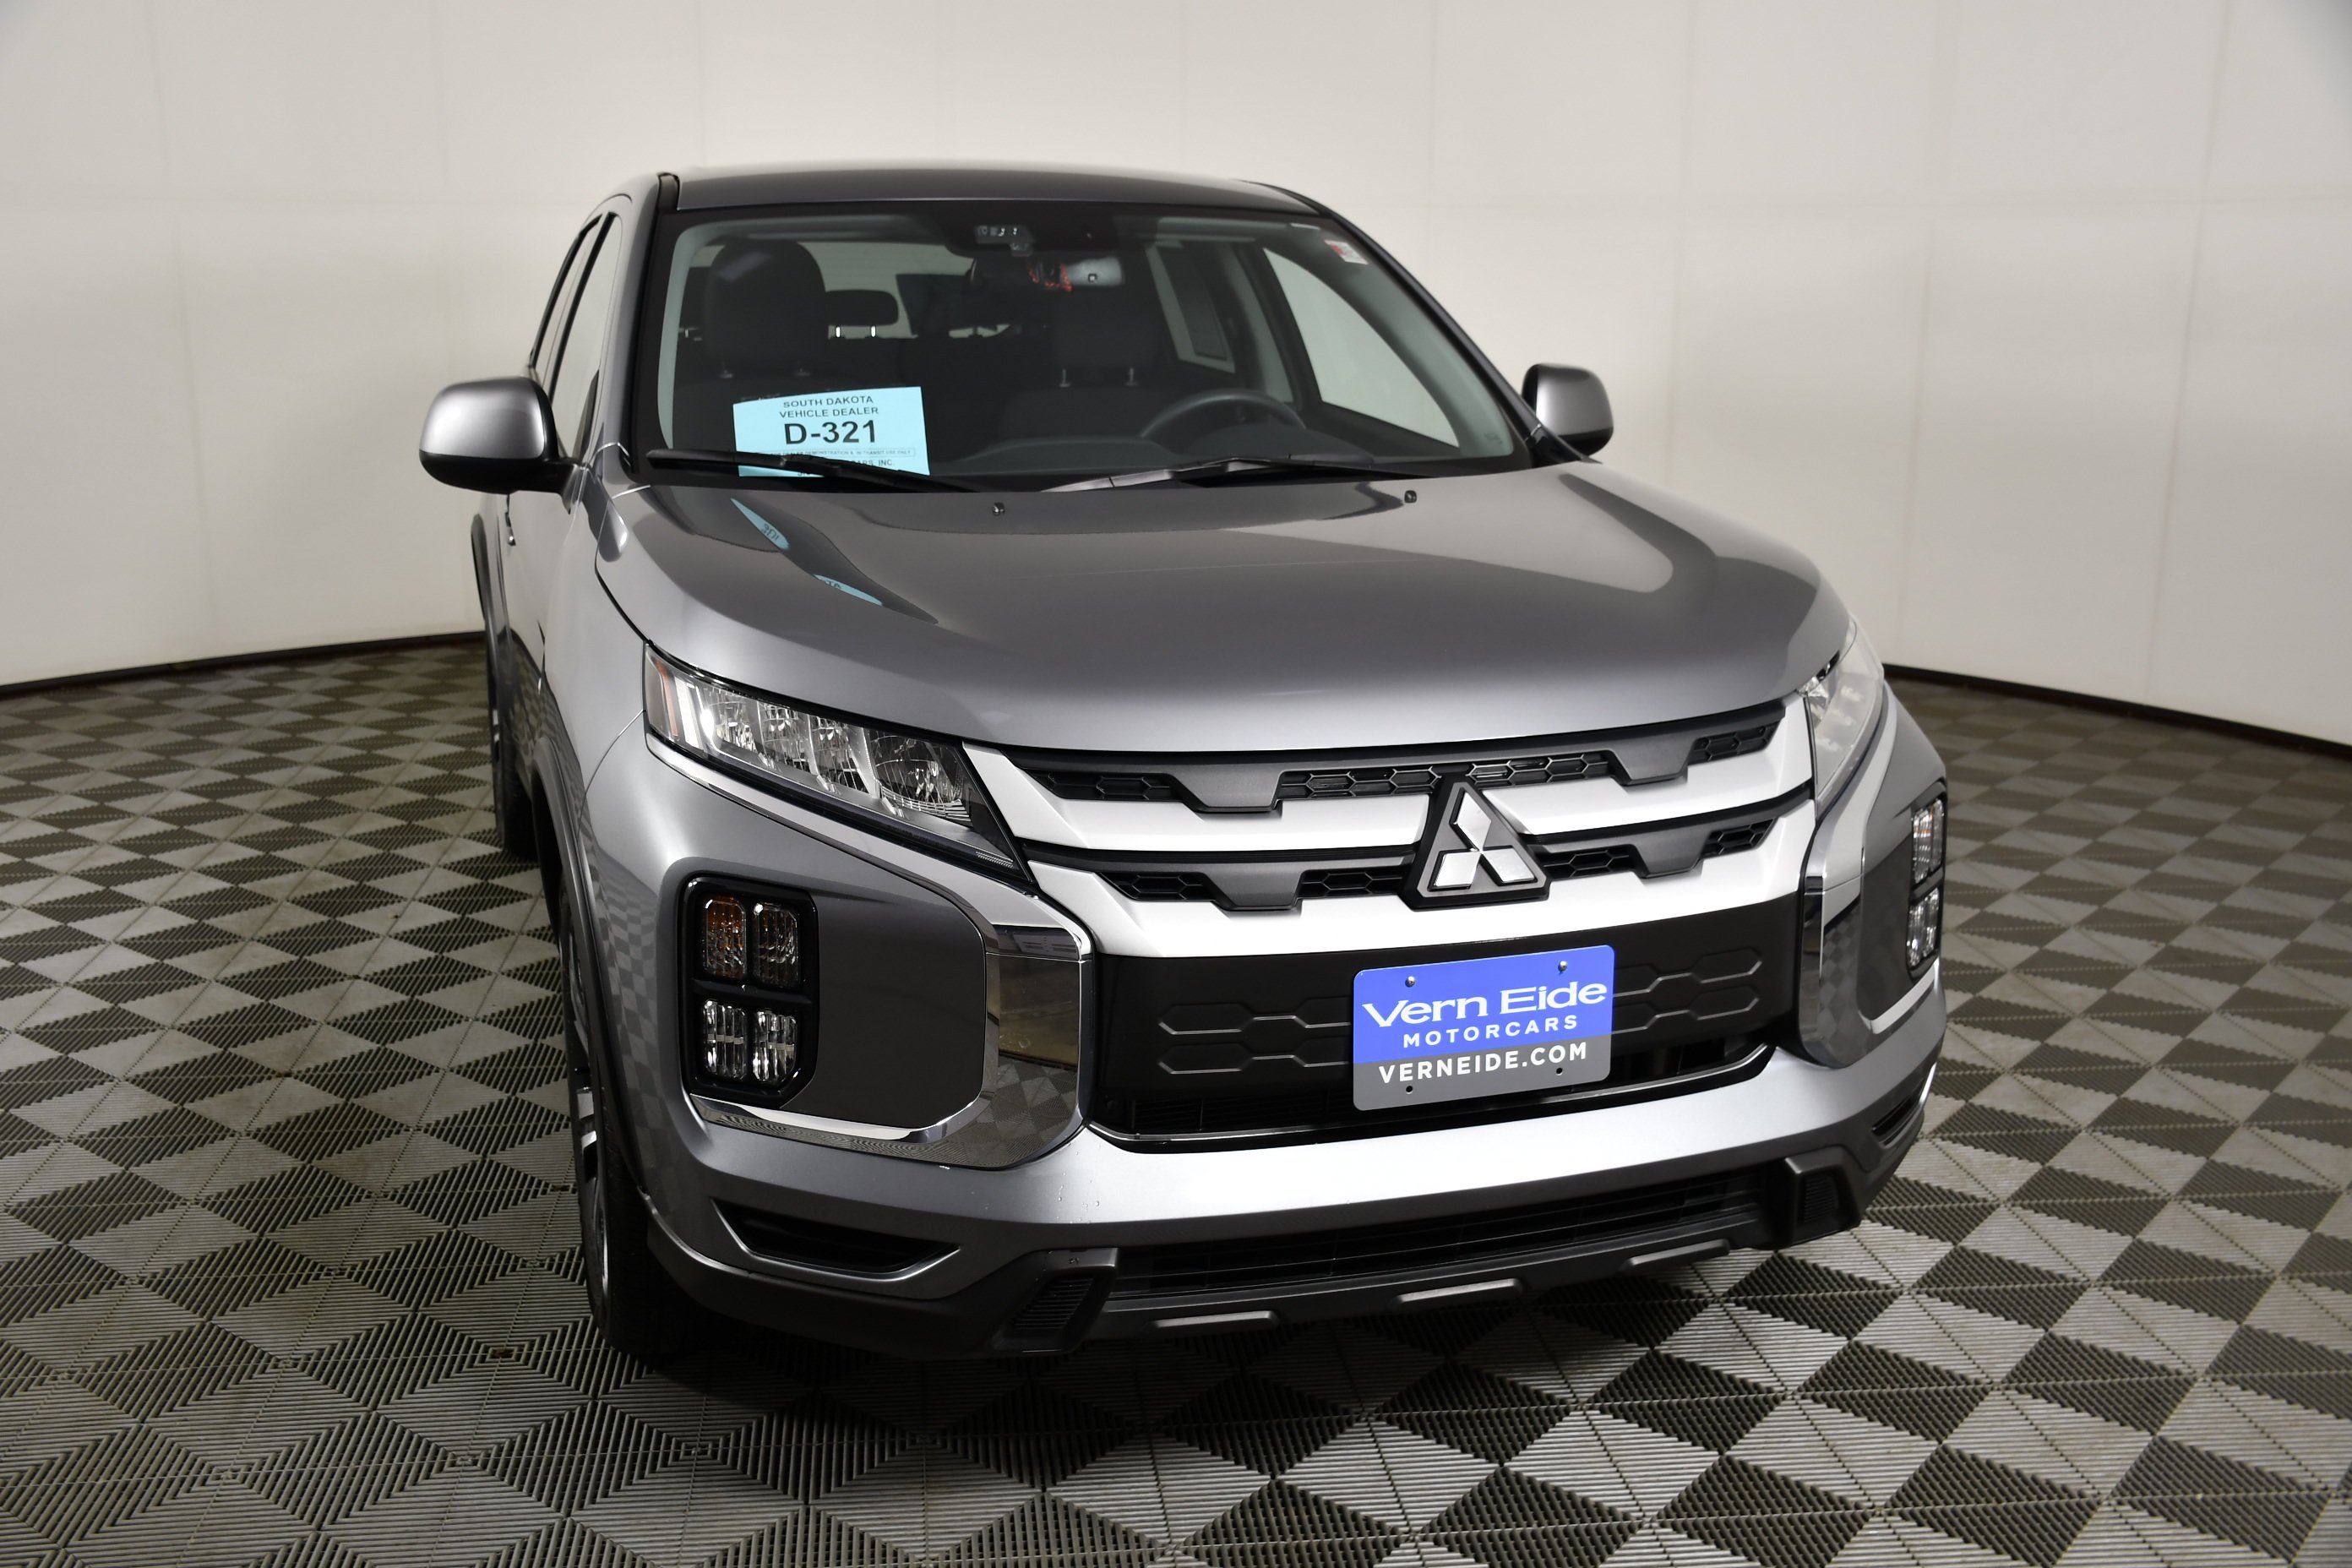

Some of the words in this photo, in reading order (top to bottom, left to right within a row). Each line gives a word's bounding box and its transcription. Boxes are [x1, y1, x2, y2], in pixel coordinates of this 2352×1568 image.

[780, 409, 829, 418] VEHICLE
[832, 406, 879, 416] DEALER
[783, 399, 823, 408] SOUTH
[826, 395, 874, 406] DAKOTA
[784, 420, 875, 444] D-321
[1362, 996, 1489, 1027] Vern
[1500, 981, 1608, 1014] Eide
[1403, 1015, 1577, 1048] MOTORCARS
[1379, 1042, 1587, 1084] VERNEIDE.COM
